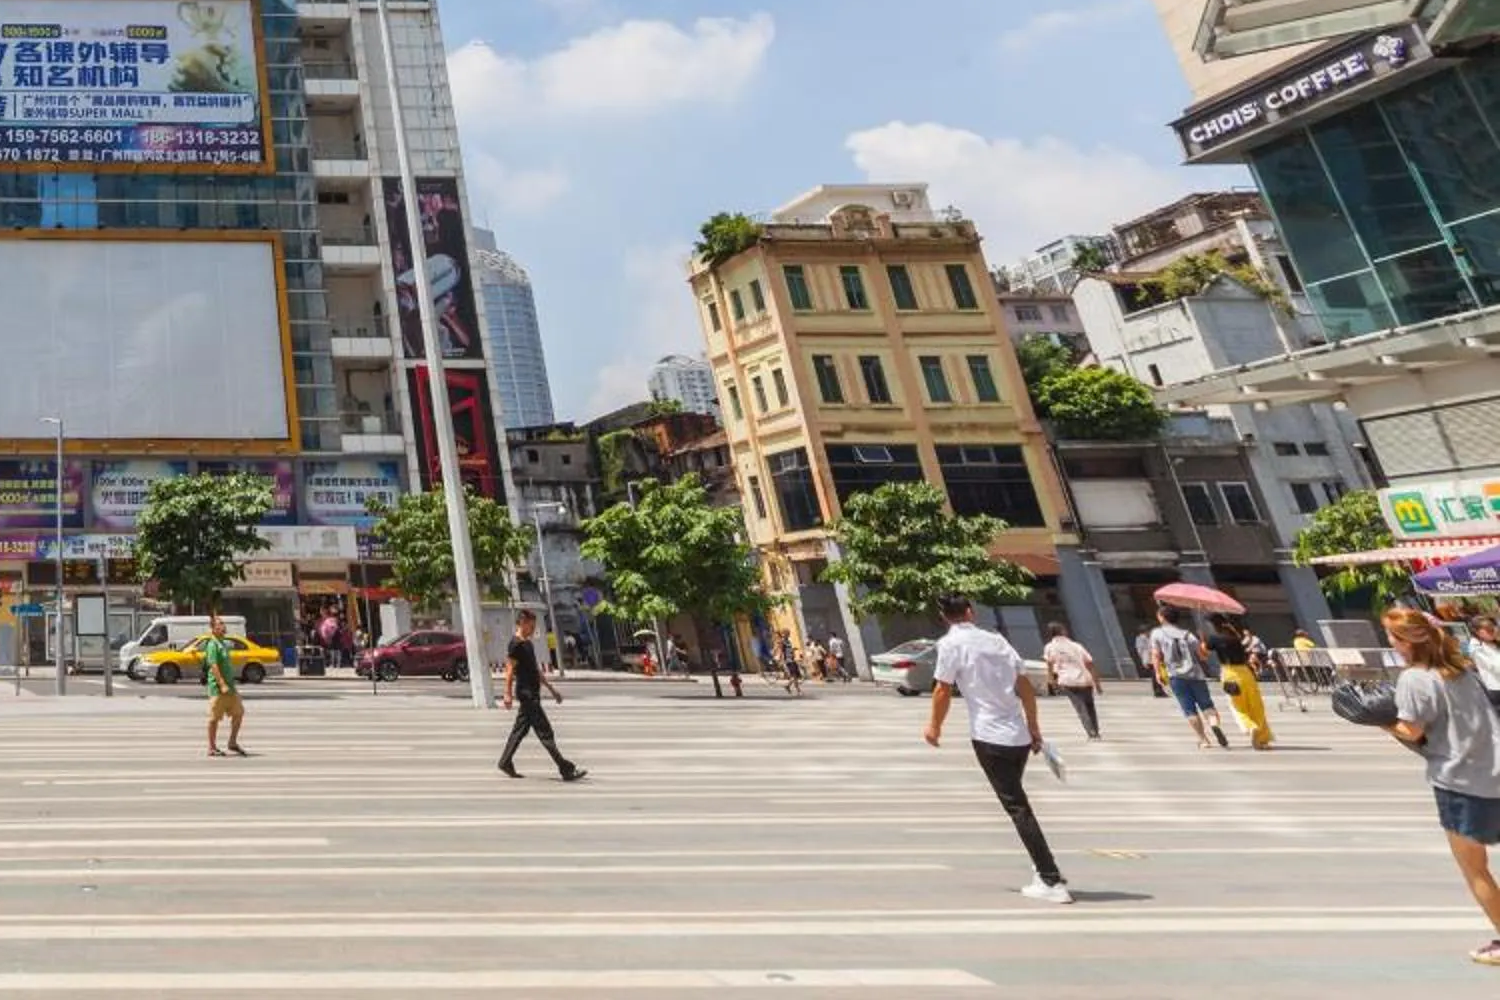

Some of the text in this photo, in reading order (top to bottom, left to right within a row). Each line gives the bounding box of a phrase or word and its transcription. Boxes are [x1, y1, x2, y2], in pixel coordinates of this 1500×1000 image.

[13, 41, 170, 64] 各课外辅导
[13, 65, 139, 87] 知名机构
[1265, 52, 1369, 110] COFFEE
